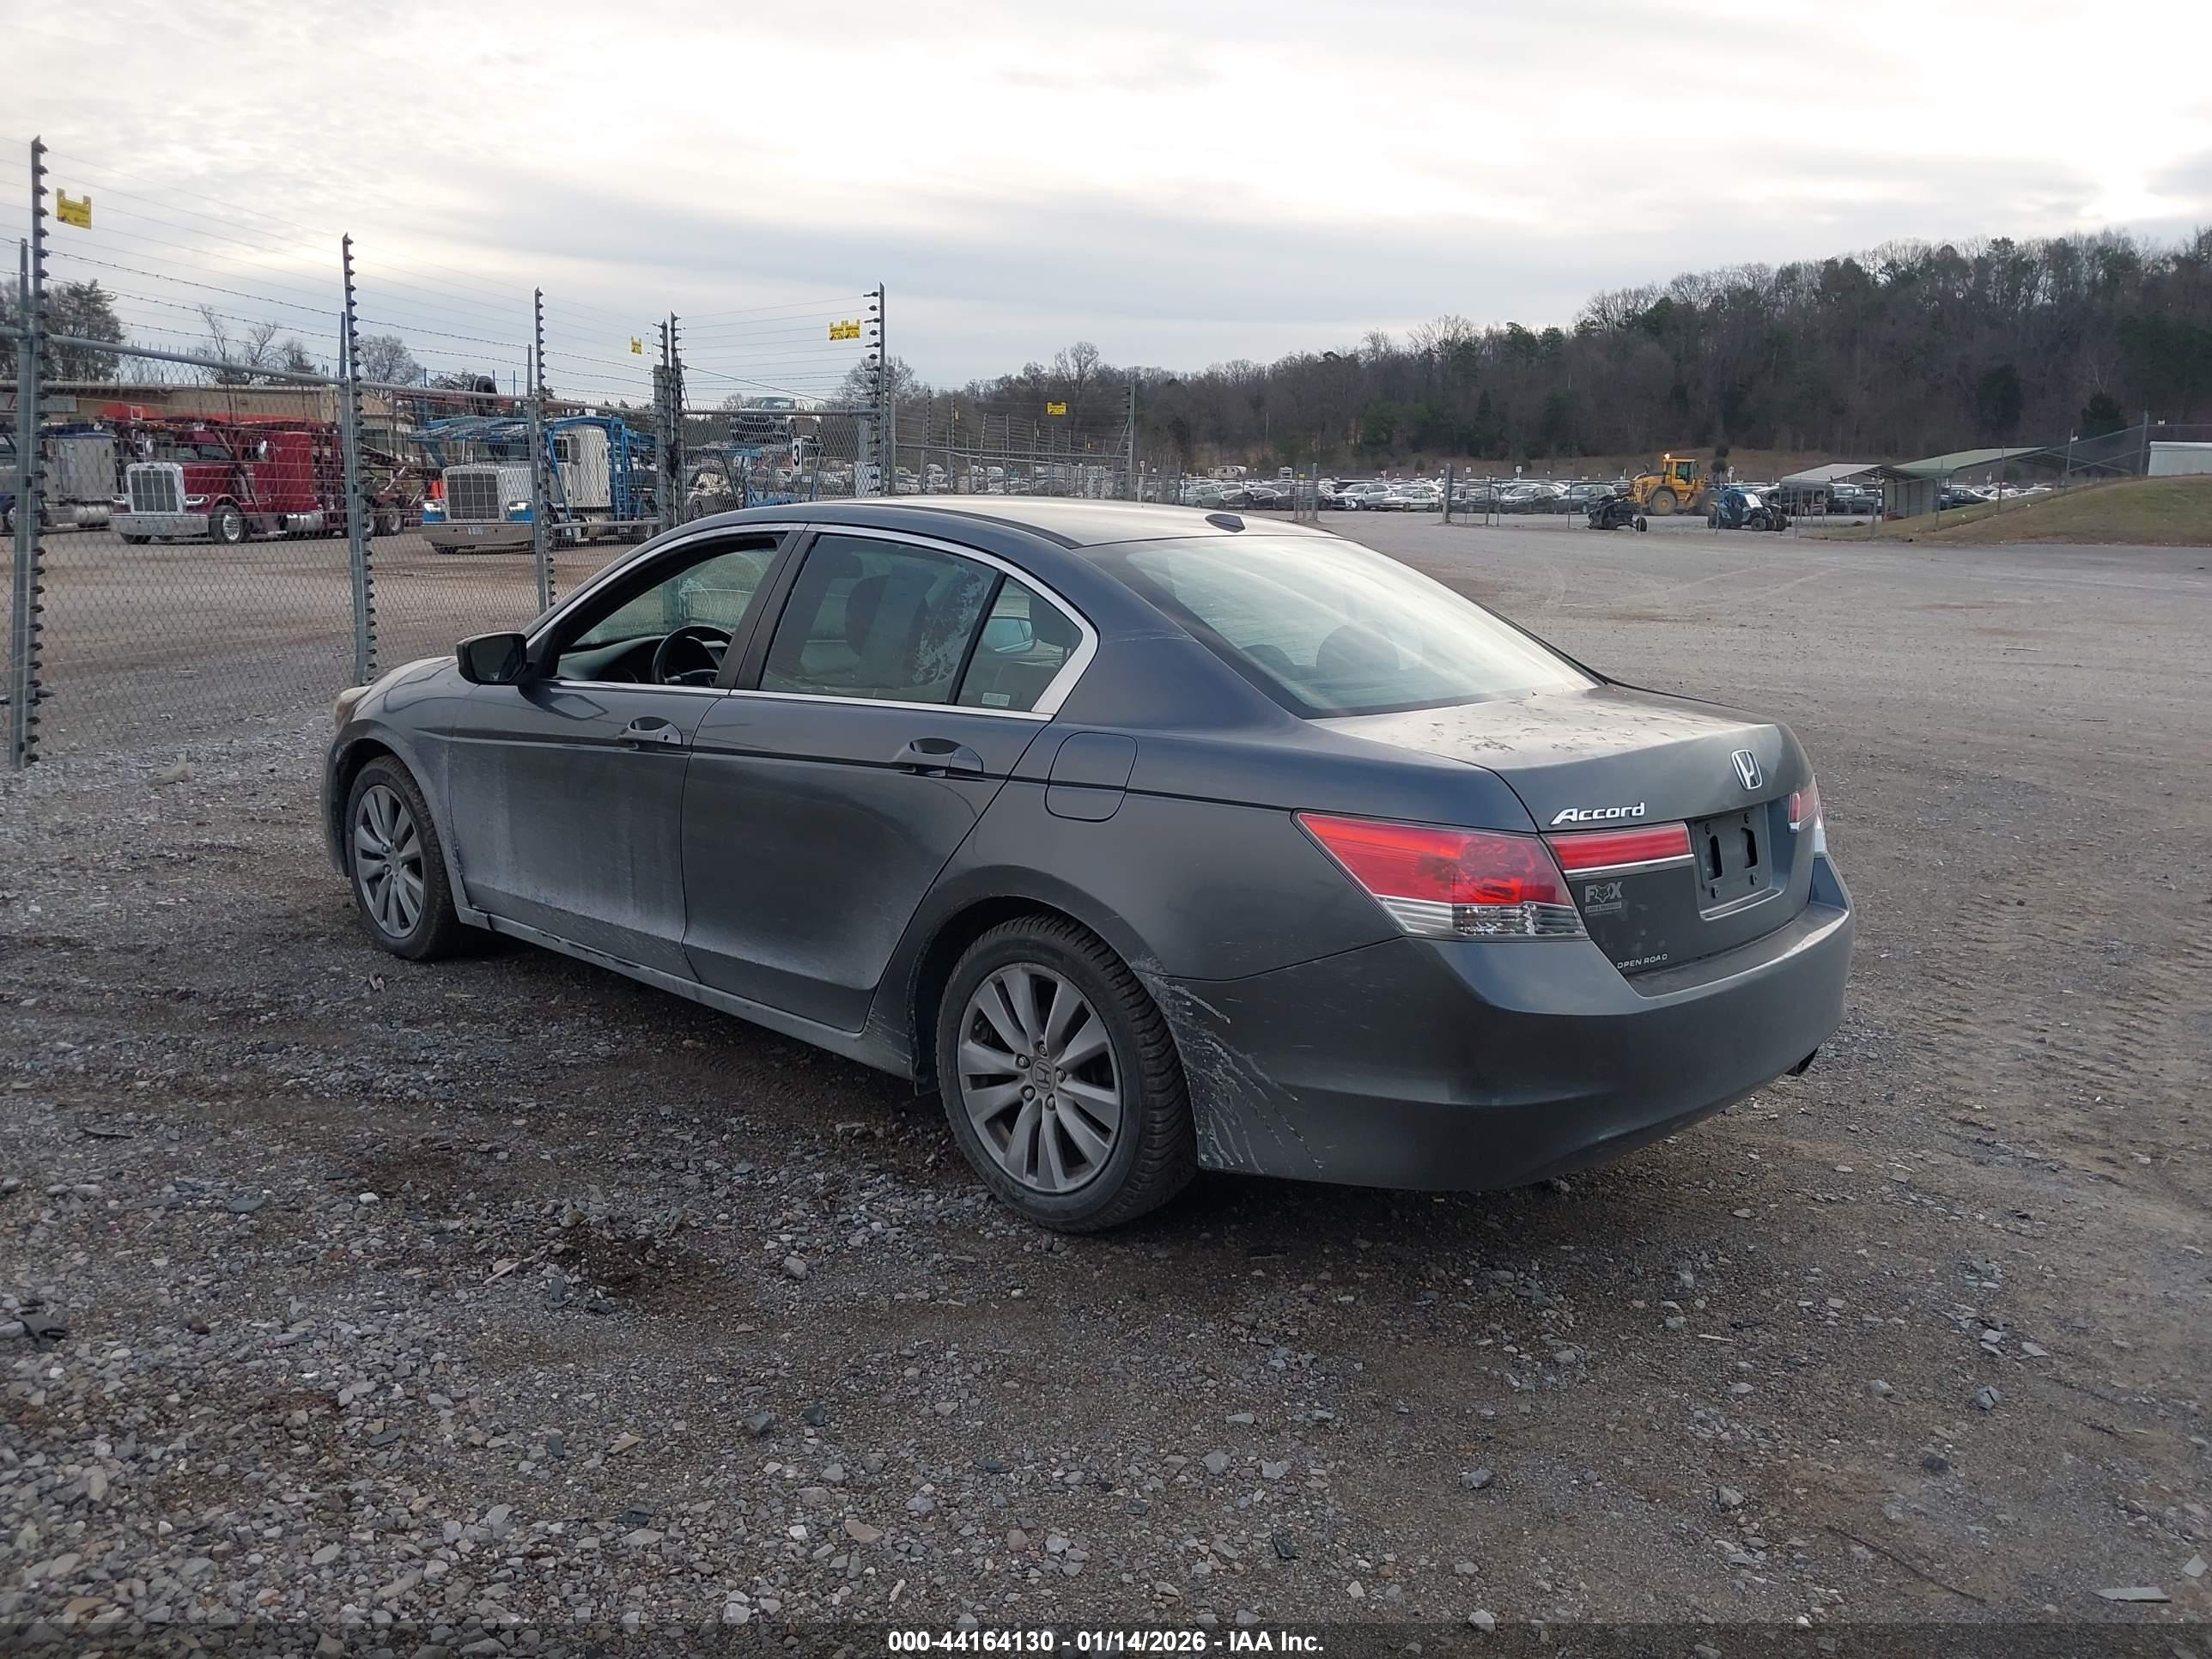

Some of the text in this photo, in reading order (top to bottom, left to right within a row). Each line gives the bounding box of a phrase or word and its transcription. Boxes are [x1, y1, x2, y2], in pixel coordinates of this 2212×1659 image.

[793, 443, 799, 466] 3
[1549, 801, 1645, 825] Accord
[1617, 953, 1668, 969] OPEN ROAD
